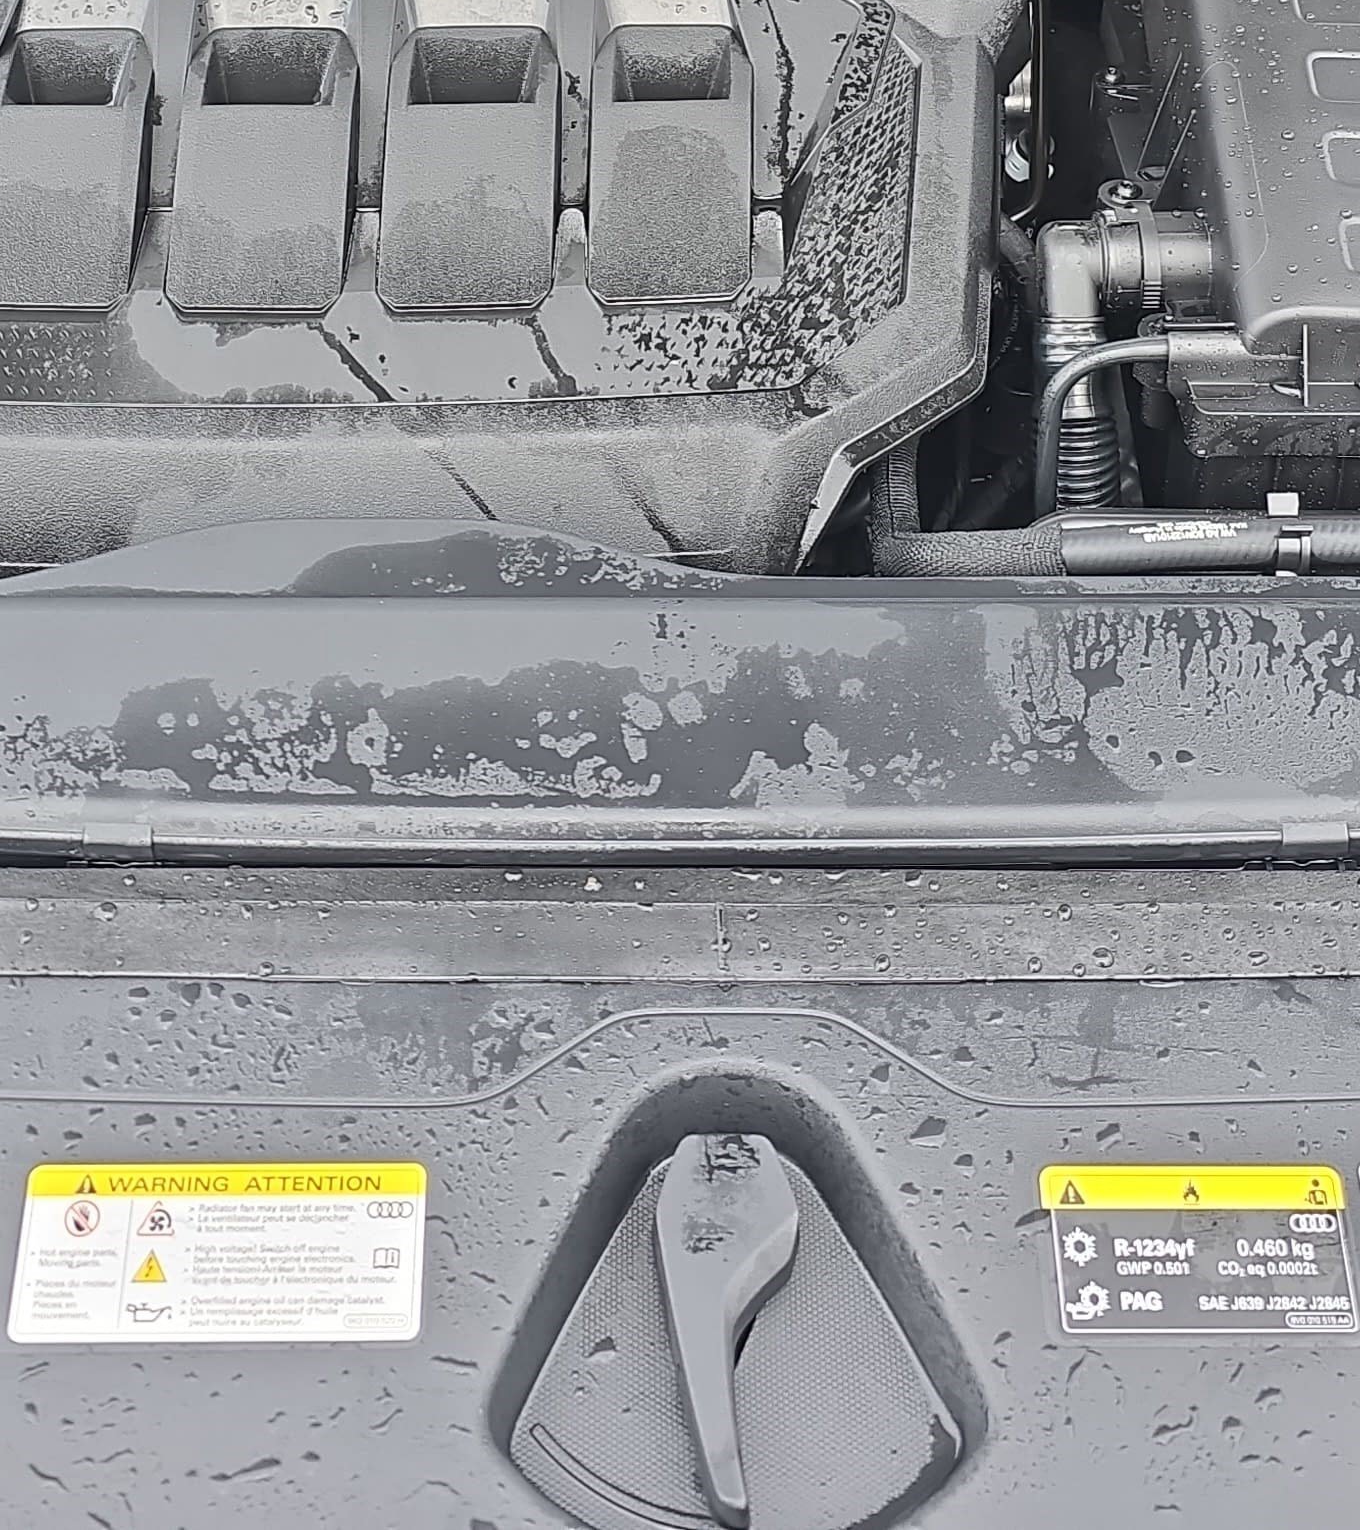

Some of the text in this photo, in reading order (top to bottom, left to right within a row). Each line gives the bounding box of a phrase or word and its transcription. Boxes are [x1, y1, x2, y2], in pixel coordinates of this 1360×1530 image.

[108, 1175, 381, 1192] WARNING ATTENTION
[240, 1204, 254, 1213] fan
[257, 1204, 278, 1213] may
[1113, 1237, 1316, 1261] R-1234yf 0.460 kg
[1116, 1260, 1152, 1276] GWP
[1153, 1260, 1191, 1276] 0.501
[1247, 1263, 1267, 1278] eq
[1119, 1290, 1163, 1311] PAG
[1199, 1294, 1230, 1311] SAE
[1231, 1294, 1265, 1311] J639
[1266, 1294, 1308, 1311] J2842
